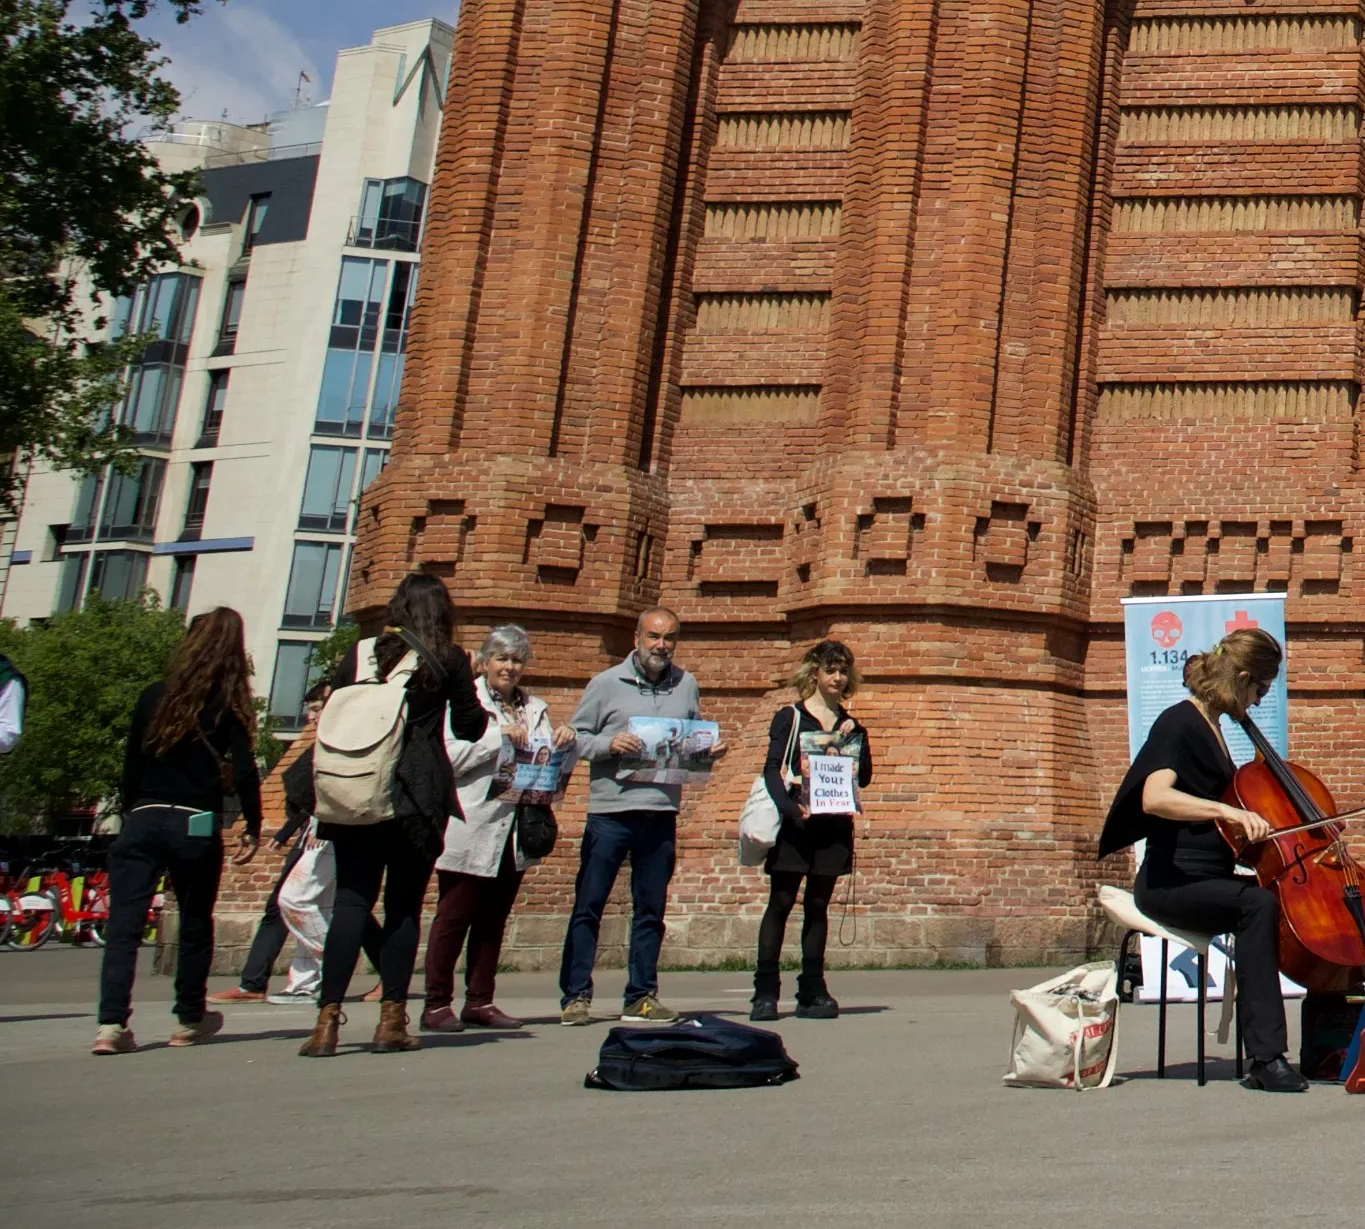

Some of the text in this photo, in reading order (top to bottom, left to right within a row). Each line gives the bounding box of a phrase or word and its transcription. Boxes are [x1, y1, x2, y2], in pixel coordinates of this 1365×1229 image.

[1150, 649, 1188, 665] 1.134
[821, 762, 845, 772] made
[818, 774, 844, 784] Your
[814, 788, 849, 798] Clothes
[816, 798, 827, 807] In
